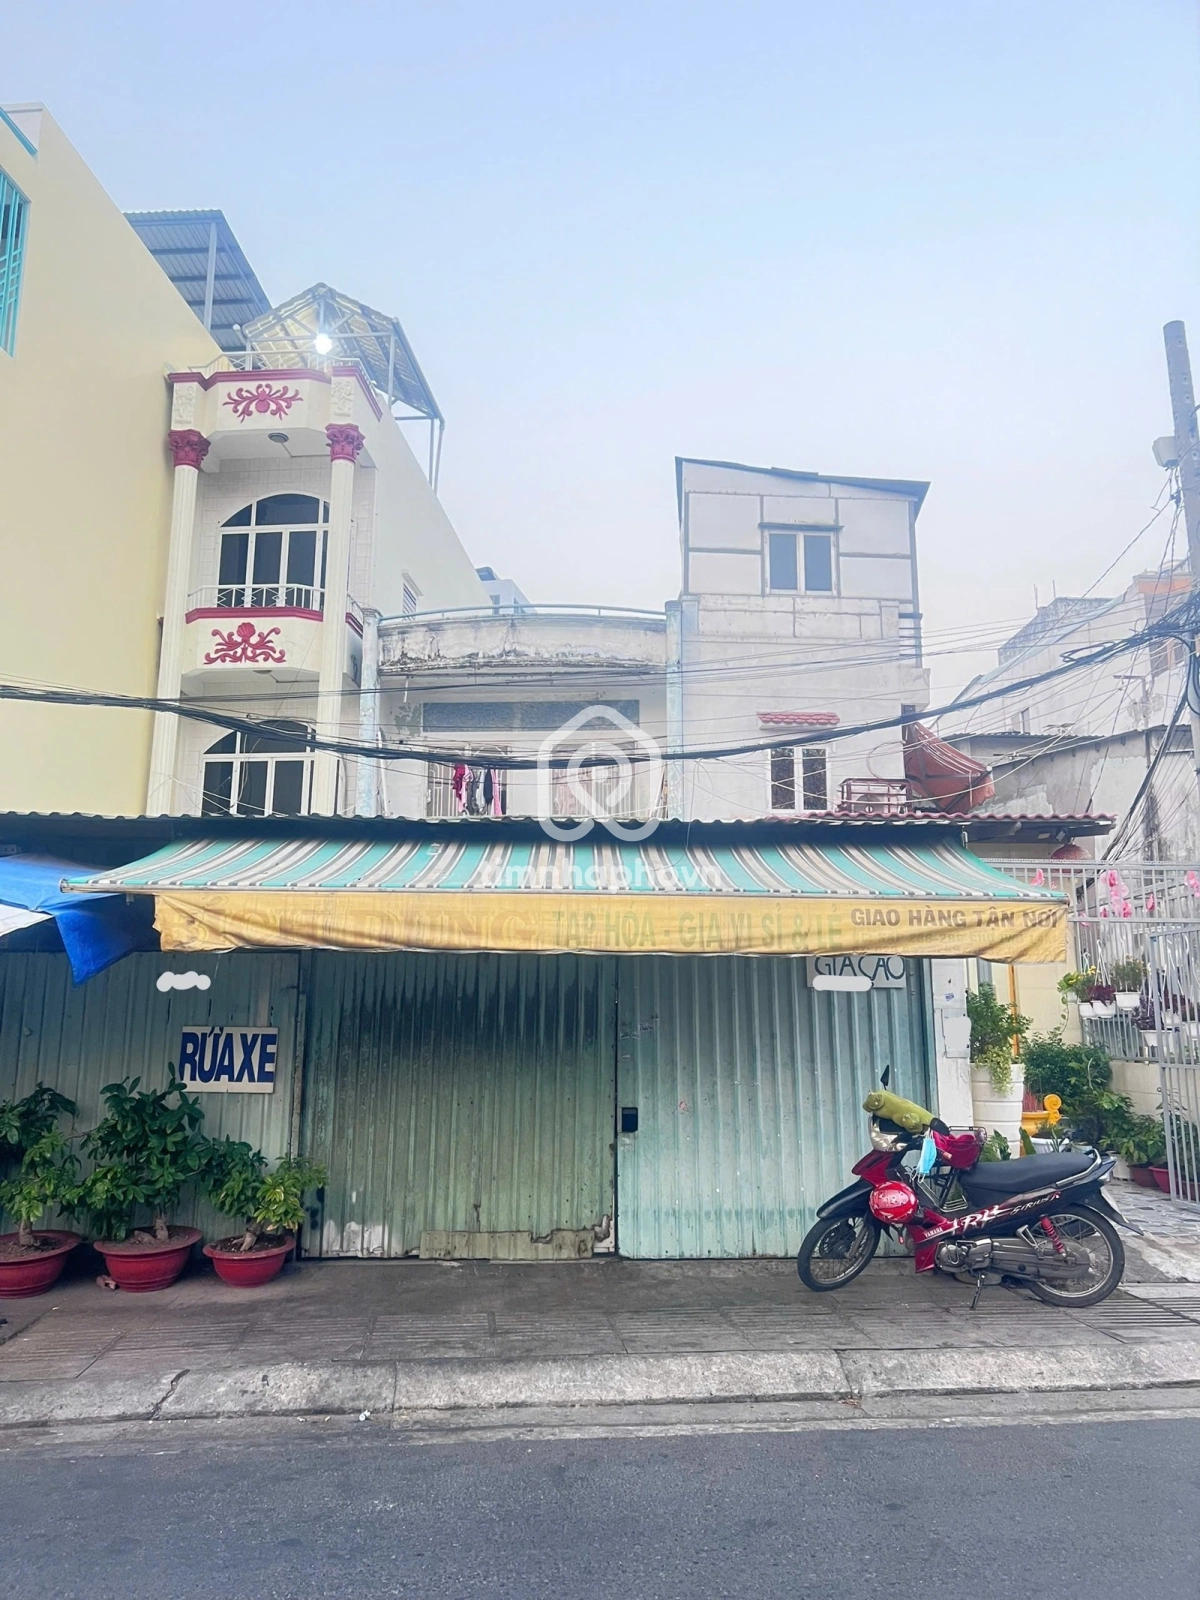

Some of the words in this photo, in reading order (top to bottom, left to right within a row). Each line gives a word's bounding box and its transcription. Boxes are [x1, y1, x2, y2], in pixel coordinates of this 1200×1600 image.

[791, 914, 809, 950] &
[850, 908, 900, 926] GIAO
[908, 905, 967, 927] HÀNG
[972, 906, 1015, 930] TẬN
